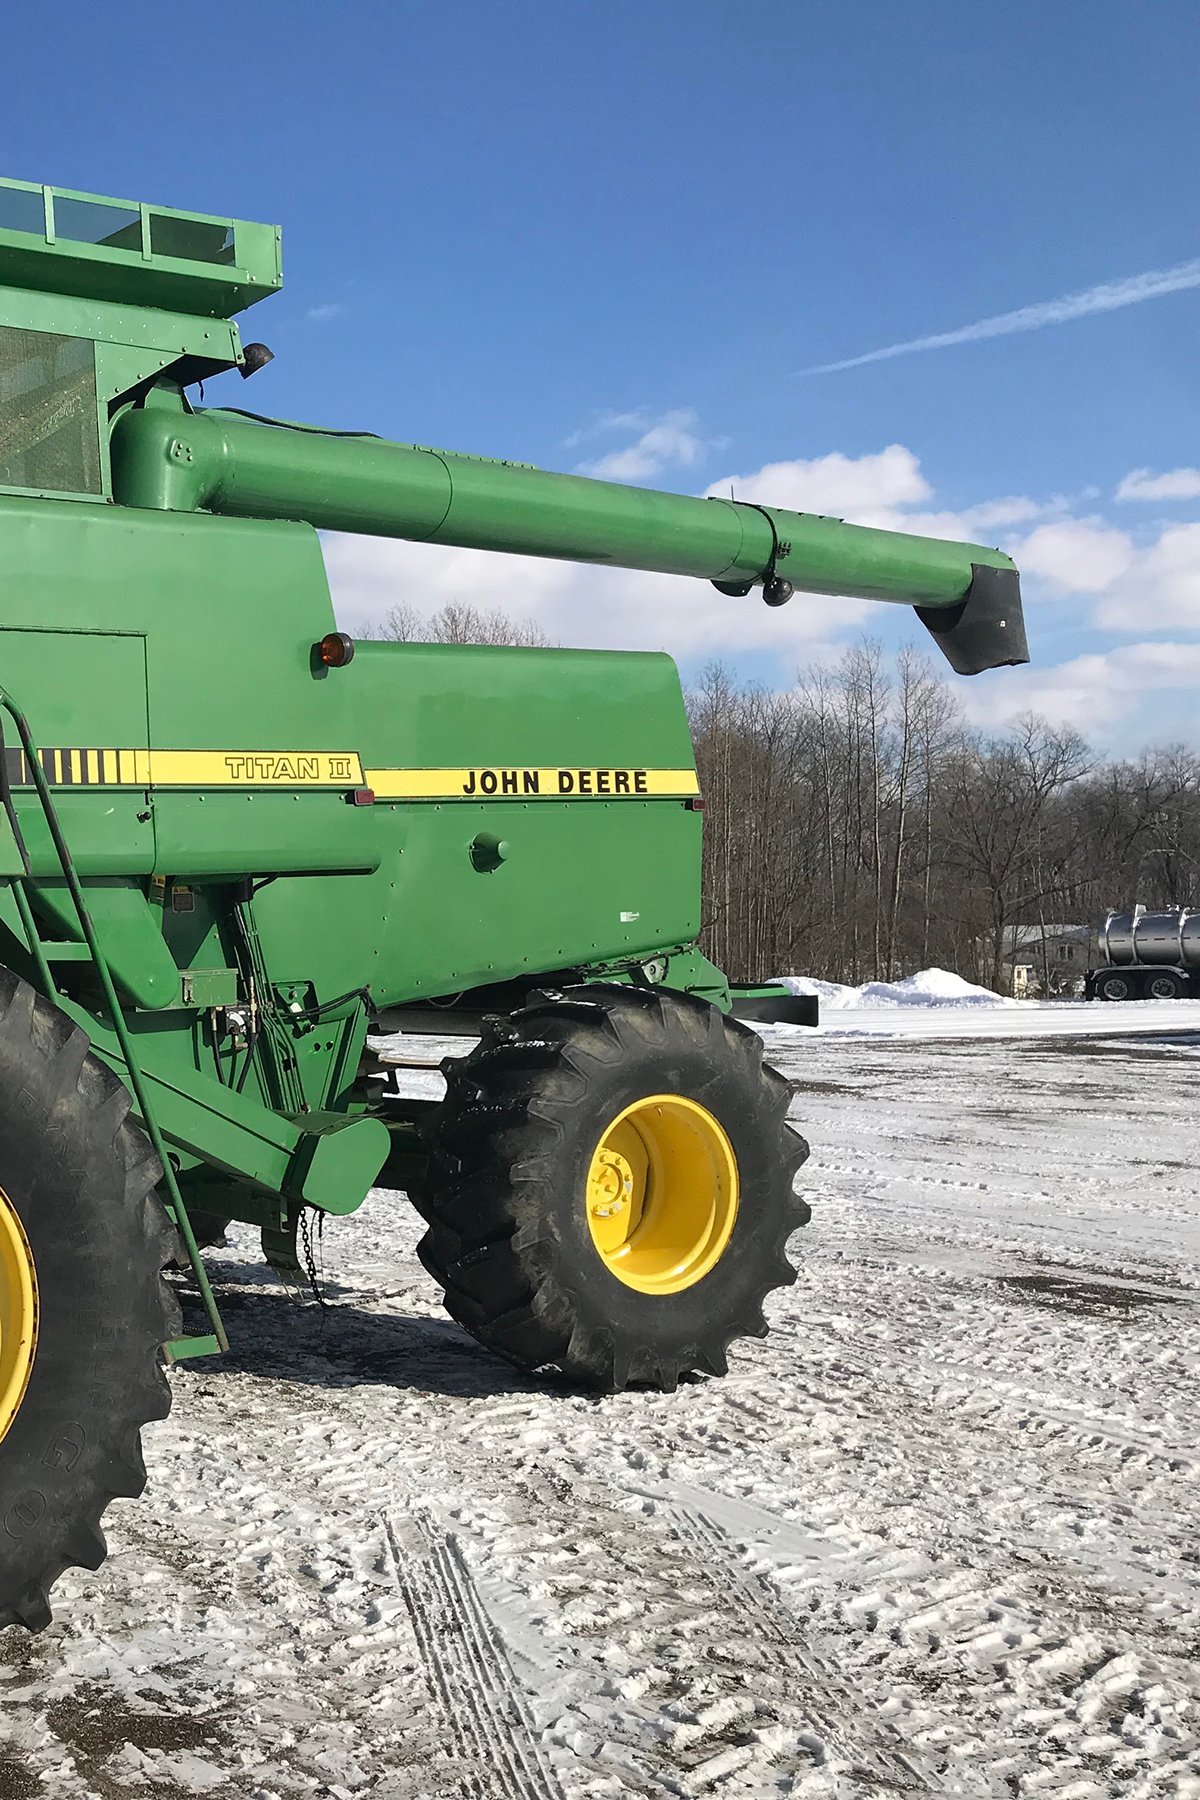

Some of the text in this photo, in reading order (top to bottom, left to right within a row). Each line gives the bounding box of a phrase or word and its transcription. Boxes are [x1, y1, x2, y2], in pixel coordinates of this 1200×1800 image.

[225, 757, 351, 779] TITAN II
[463, 771, 648, 794] JOHN DEERE
